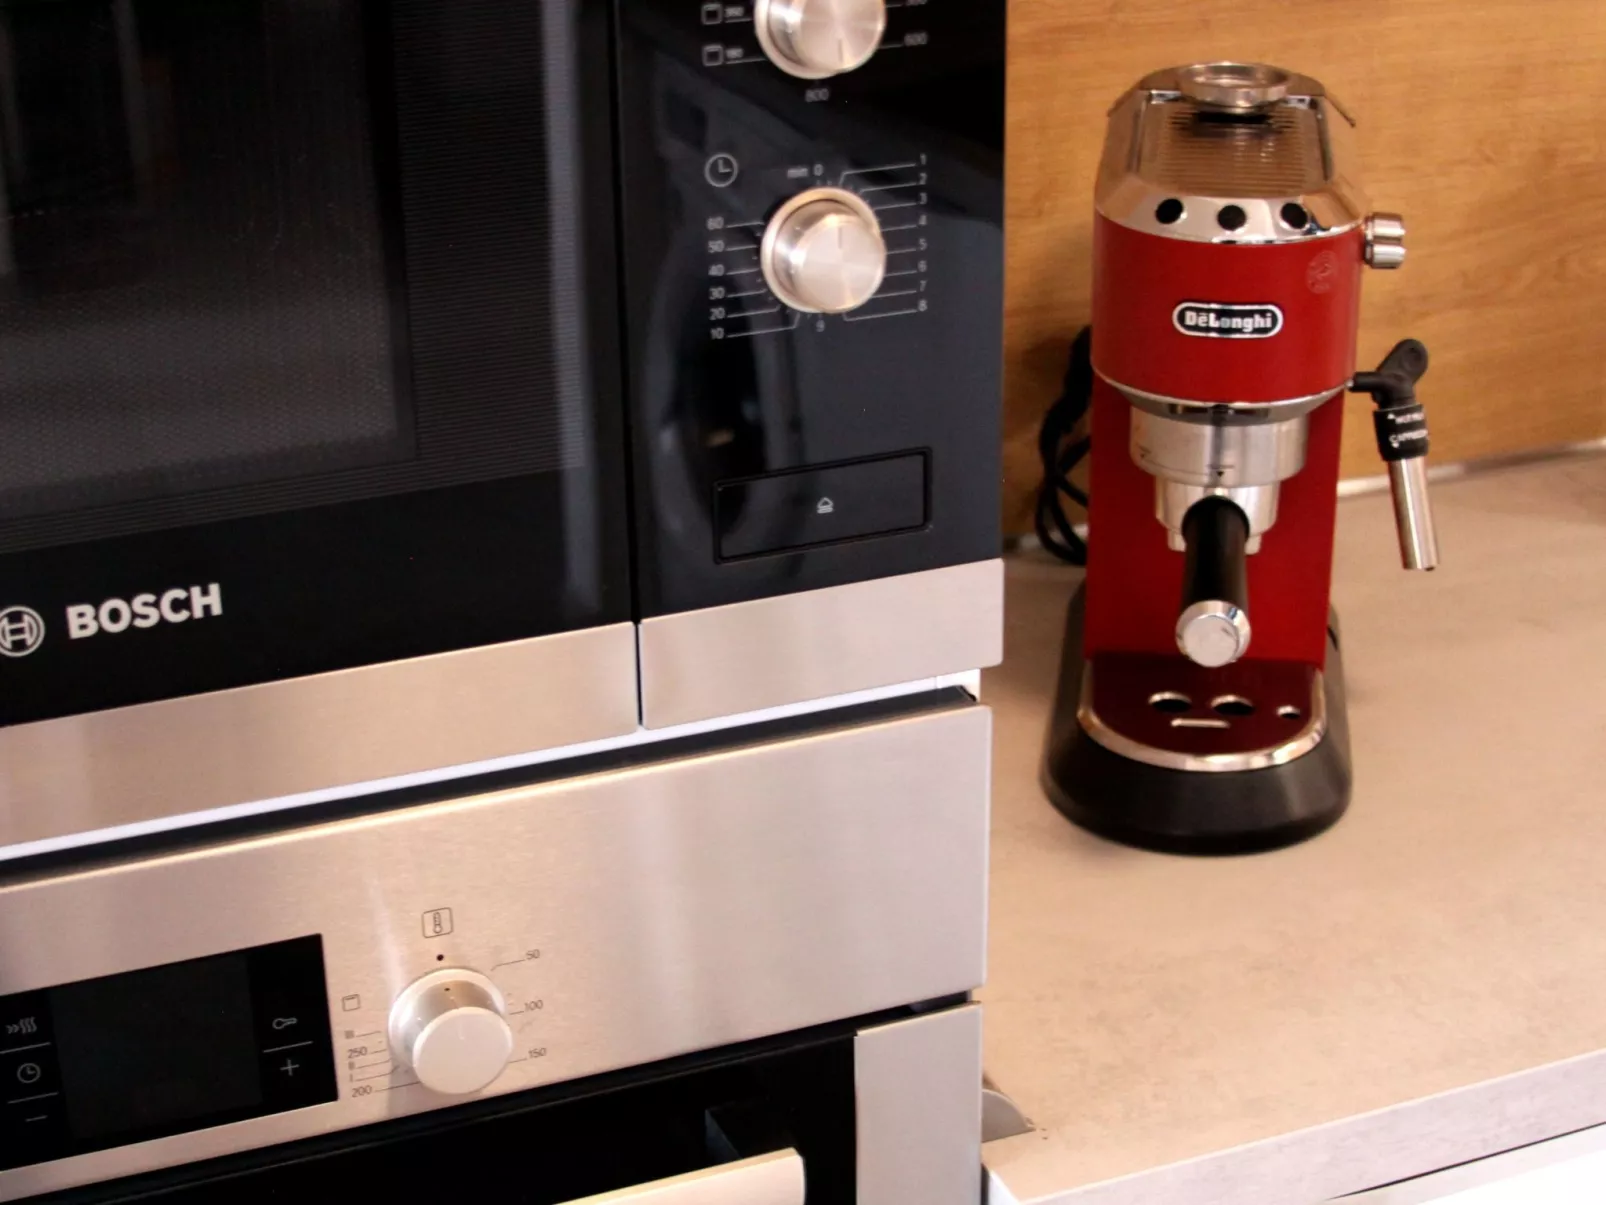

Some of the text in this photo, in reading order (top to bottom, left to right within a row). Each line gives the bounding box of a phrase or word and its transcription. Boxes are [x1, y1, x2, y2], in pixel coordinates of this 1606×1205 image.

[919, 238, 927, 250] 5
[919, 280, 928, 292] 7
[709, 287, 725, 300] 30
[709, 307, 726, 320] 20
[711, 328, 724, 340] 10
[66, 583, 223, 639] BOSCH
[525, 949, 541, 961] 50
[524, 1000, 543, 1013] 100
[347, 1046, 368, 1059] 250
[528, 1048, 547, 1060] 150
[351, 1085, 373, 1098] 200
